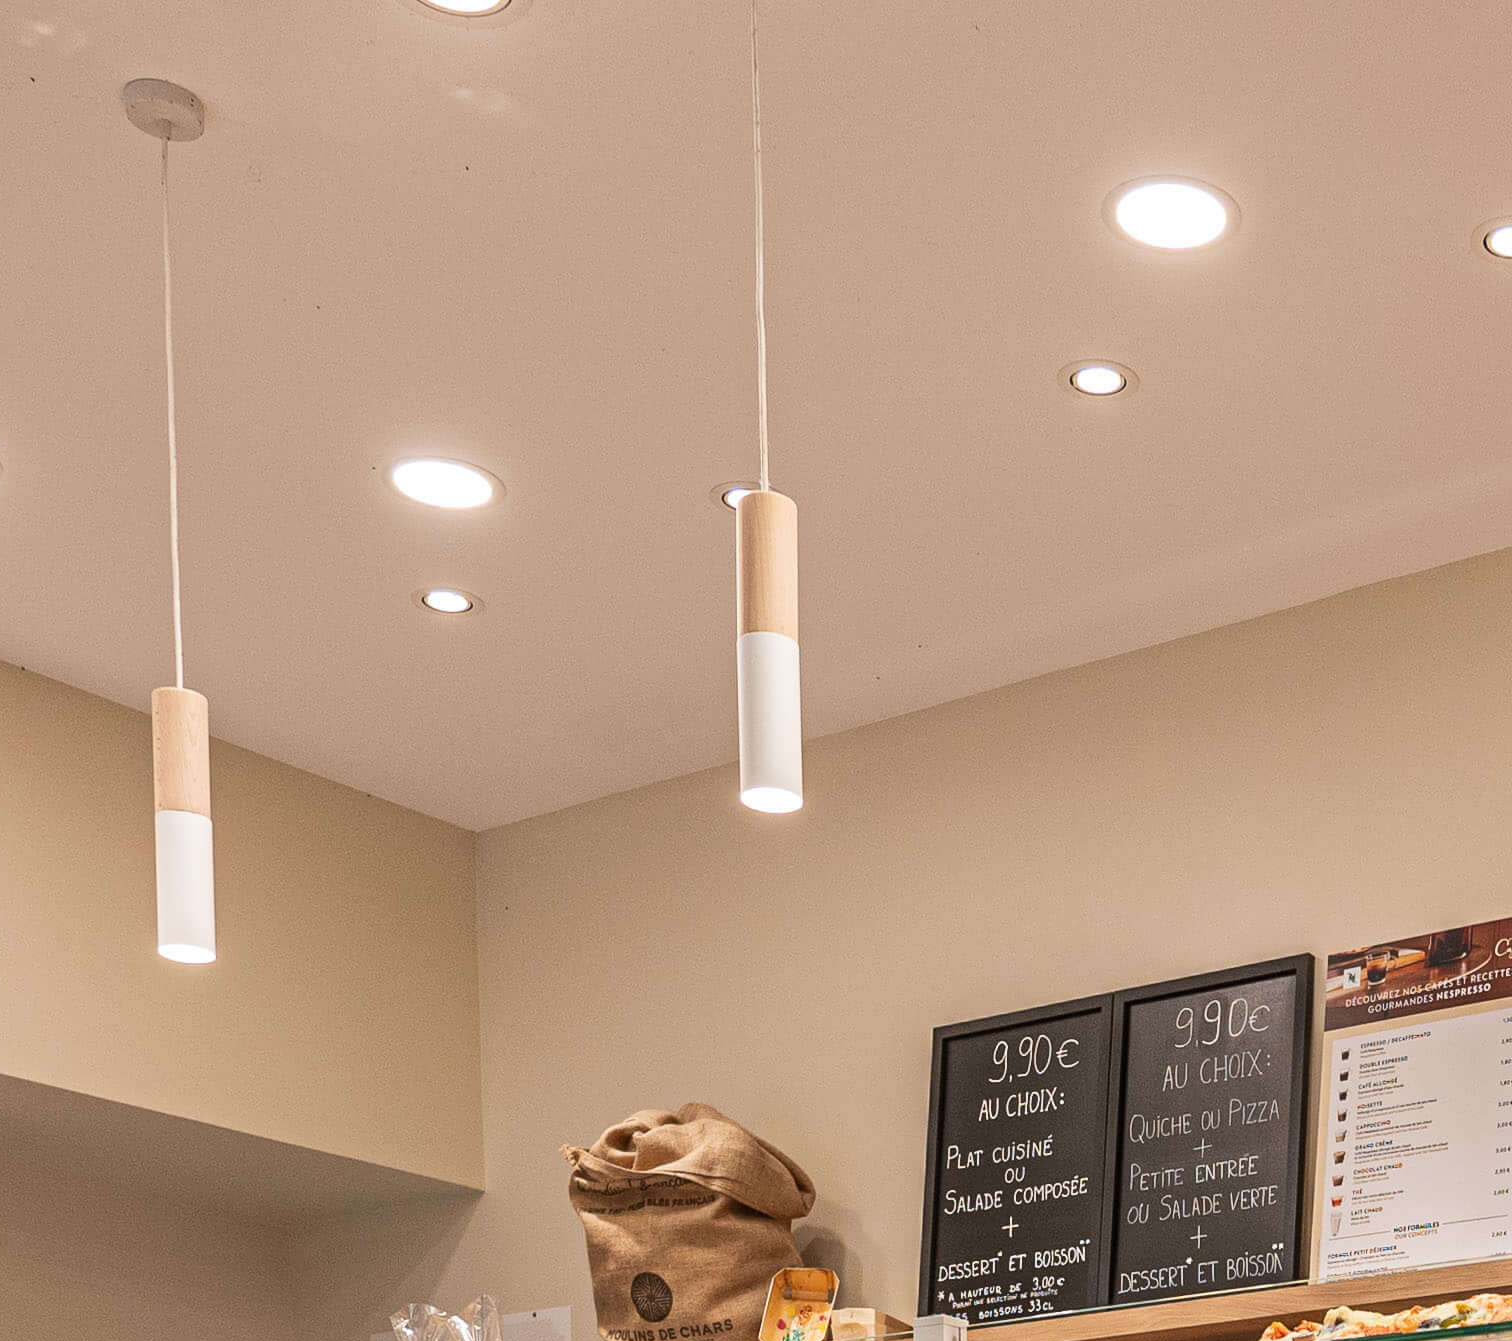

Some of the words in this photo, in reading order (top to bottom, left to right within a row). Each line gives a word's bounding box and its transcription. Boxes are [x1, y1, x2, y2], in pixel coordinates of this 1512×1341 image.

[1345, 989, 1400, 1008] DÉCOUVREZ
[1402, 986, 1423, 996] NOS
[1456, 977, 1467, 986] ET
[1367, 993, 1434, 1014] GOURMANDES
[1436, 983, 1492, 1001] NESPRESSO
[1174, 998, 1271, 1048] 9,90€
[1162, 1063, 1188, 1092] AU
[1199, 1049, 1271, 1084] CHOIX:
[978, 1097, 999, 1122] AU
[1006, 1086, 1065, 1117] CHOIX:
[1129, 1113, 1192, 1144] QUICHE
[1201, 1109, 1220, 1132] OU
[1229, 1098, 1280, 1127] PIZZA
[946, 1145, 984, 1170] PLAT
[992, 1134, 1053, 1164] CUISINÉ
[1004, 1166, 1026, 1184] OU
[1129, 1163, 1185, 1191] PETITE
[1195, 1152, 1259, 1184] ENTRÉE
[944, 1189, 1003, 1215] SALADE
[1014, 1175, 1089, 1205] COMPOSÉE
[1127, 1203, 1150, 1225] OU
[1159, 1193, 1223, 1221] SALADE
[1230, 1185, 1279, 1211] VERTE
[1008, 1253, 1027, 1272] ET
[1198, 1261, 1219, 1284] ET
[960, 1285, 1002, 1298] HAUTEUR
[1009, 1282, 1022, 1293] DE
[978, 1305, 1023, 1320] BOISSONS
[659, 1328, 677, 1340] DE
[680, 1319, 733, 1338] CHARS
